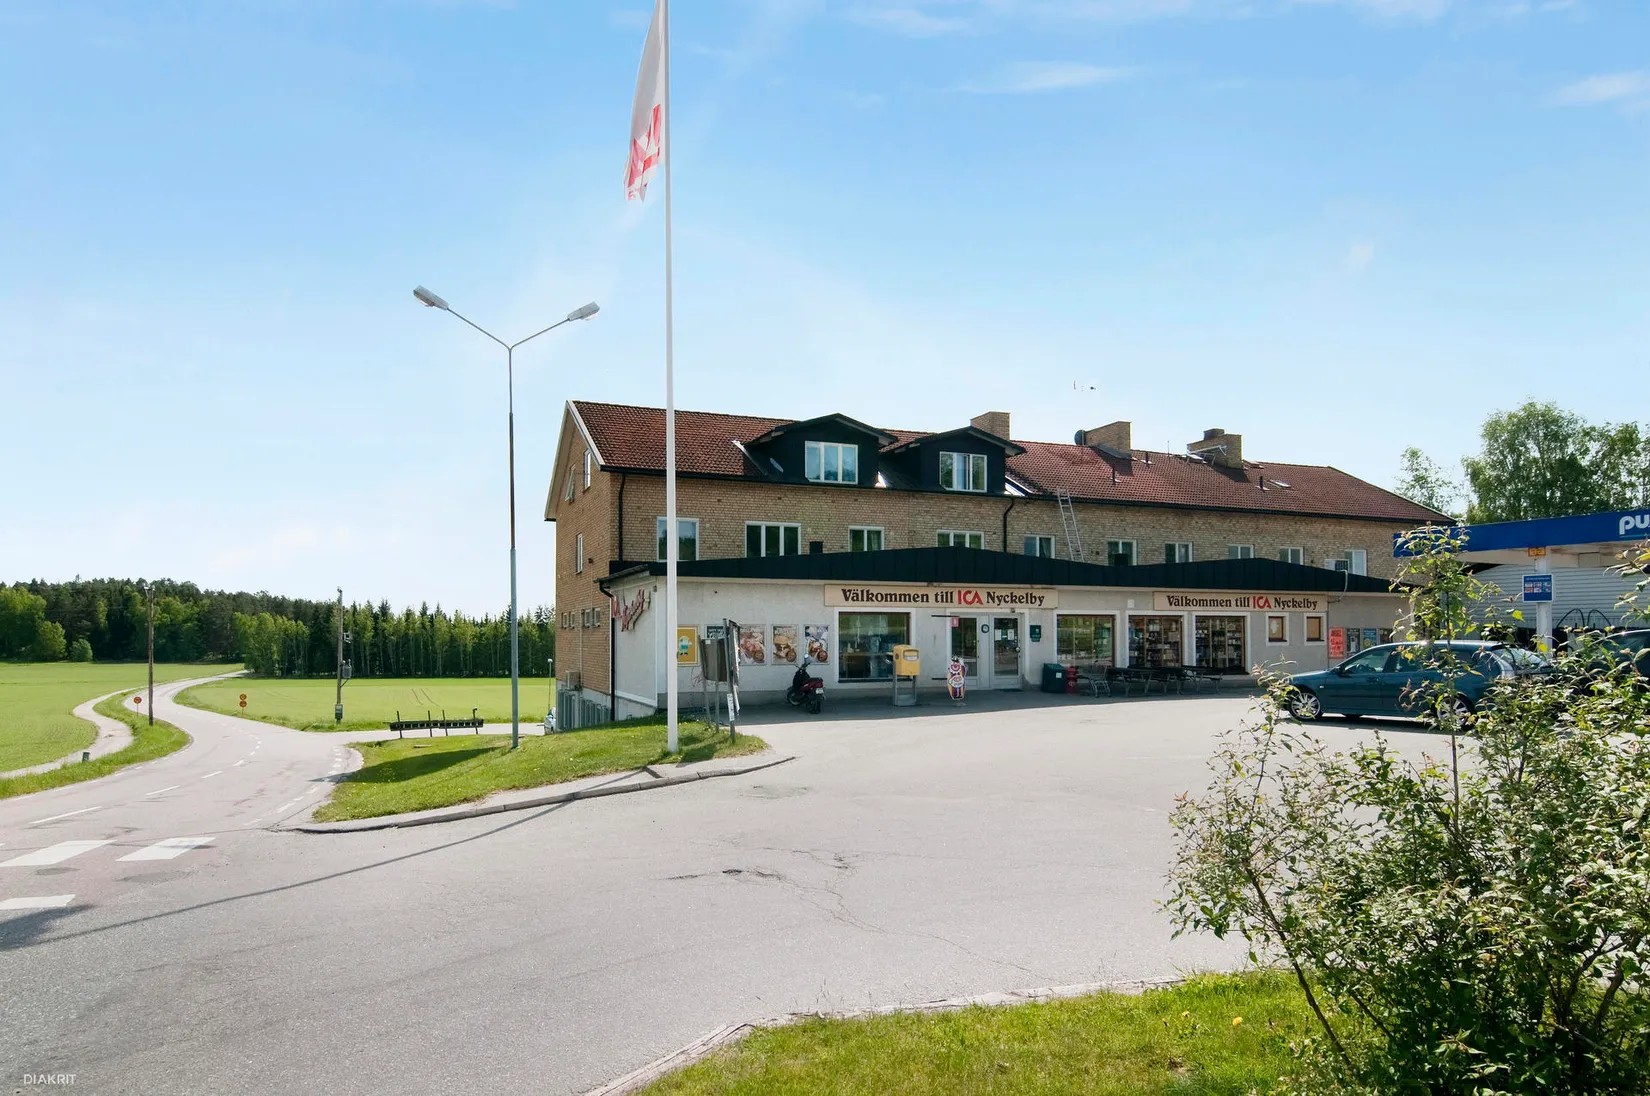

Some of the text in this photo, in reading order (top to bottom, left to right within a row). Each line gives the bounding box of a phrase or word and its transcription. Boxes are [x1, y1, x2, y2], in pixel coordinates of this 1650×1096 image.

[1619, 514, 1650, 535] pu
[841, 588, 1045, 607] Välkommen till ICA Nyckelby
[1166, 595, 1318, 610] Välkommen till ICA Nyckelby
